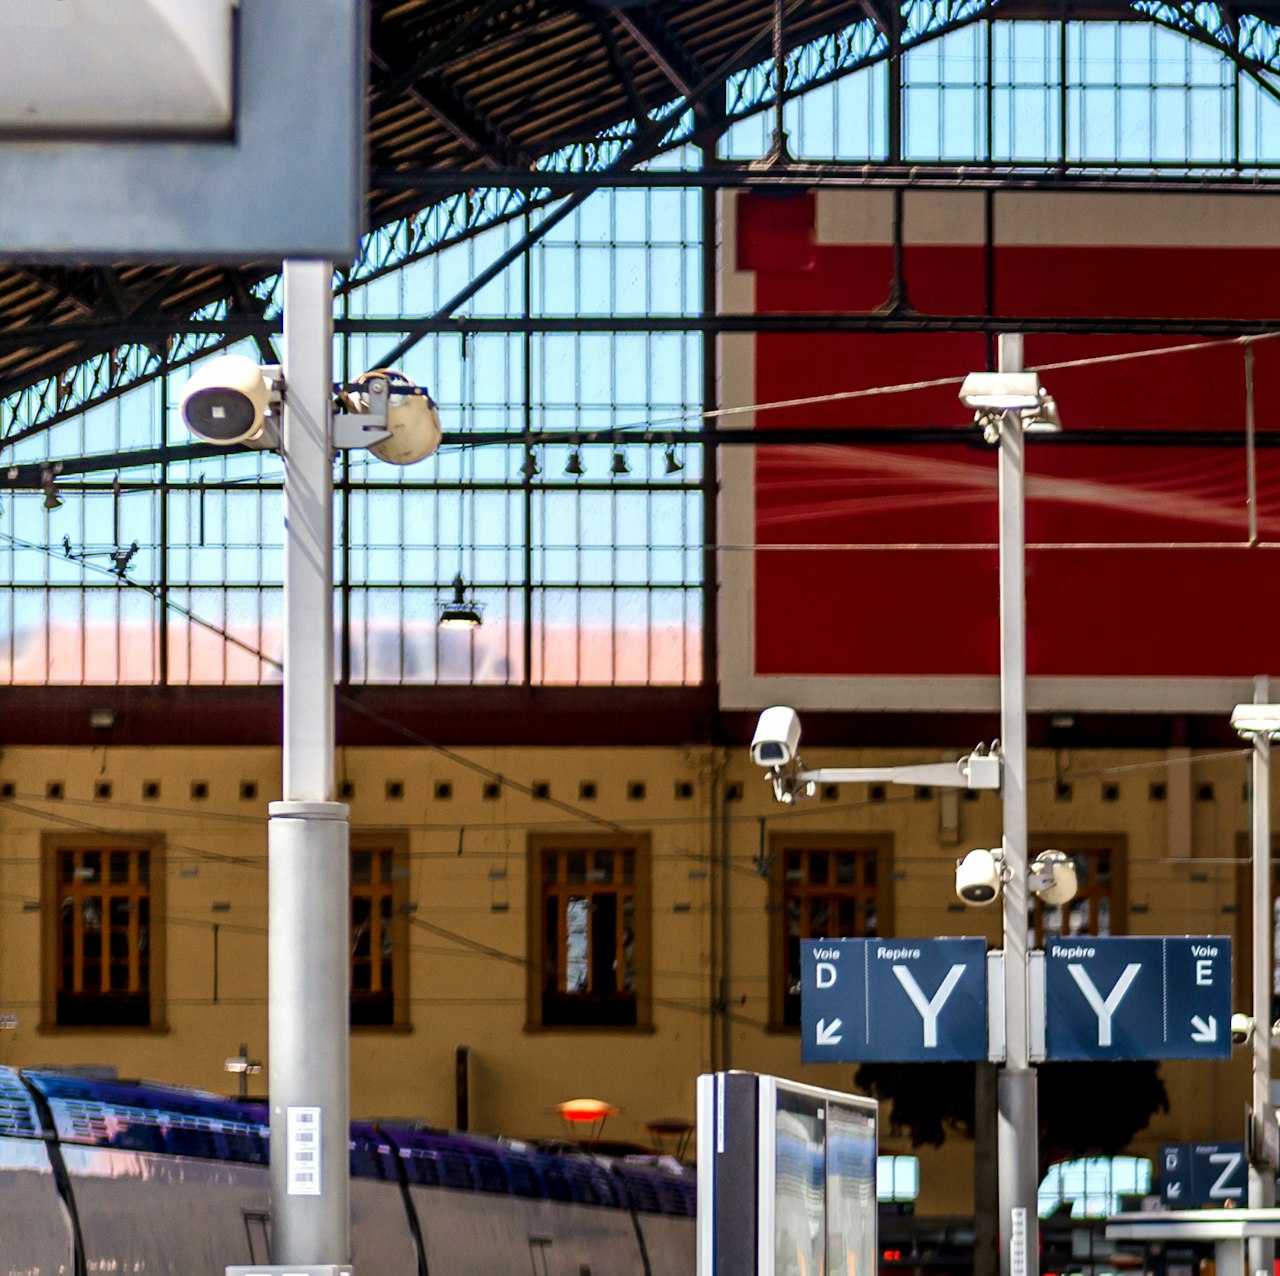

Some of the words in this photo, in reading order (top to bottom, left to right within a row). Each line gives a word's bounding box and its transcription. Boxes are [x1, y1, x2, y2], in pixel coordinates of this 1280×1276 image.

[813, 947, 840, 960] Voie
[877, 946, 921, 961] Repère
[1052, 945, 1096, 959] Repère
[1191, 945, 1219, 958] Voie
[816, 962, 837, 989] D
[1196, 960, 1213, 986] E
[892, 963, 967, 1048] Y
[1067, 963, 1142, 1047] Y
[1166, 1154, 1178, 1171] D
[1209, 1152, 1242, 1198] Z
